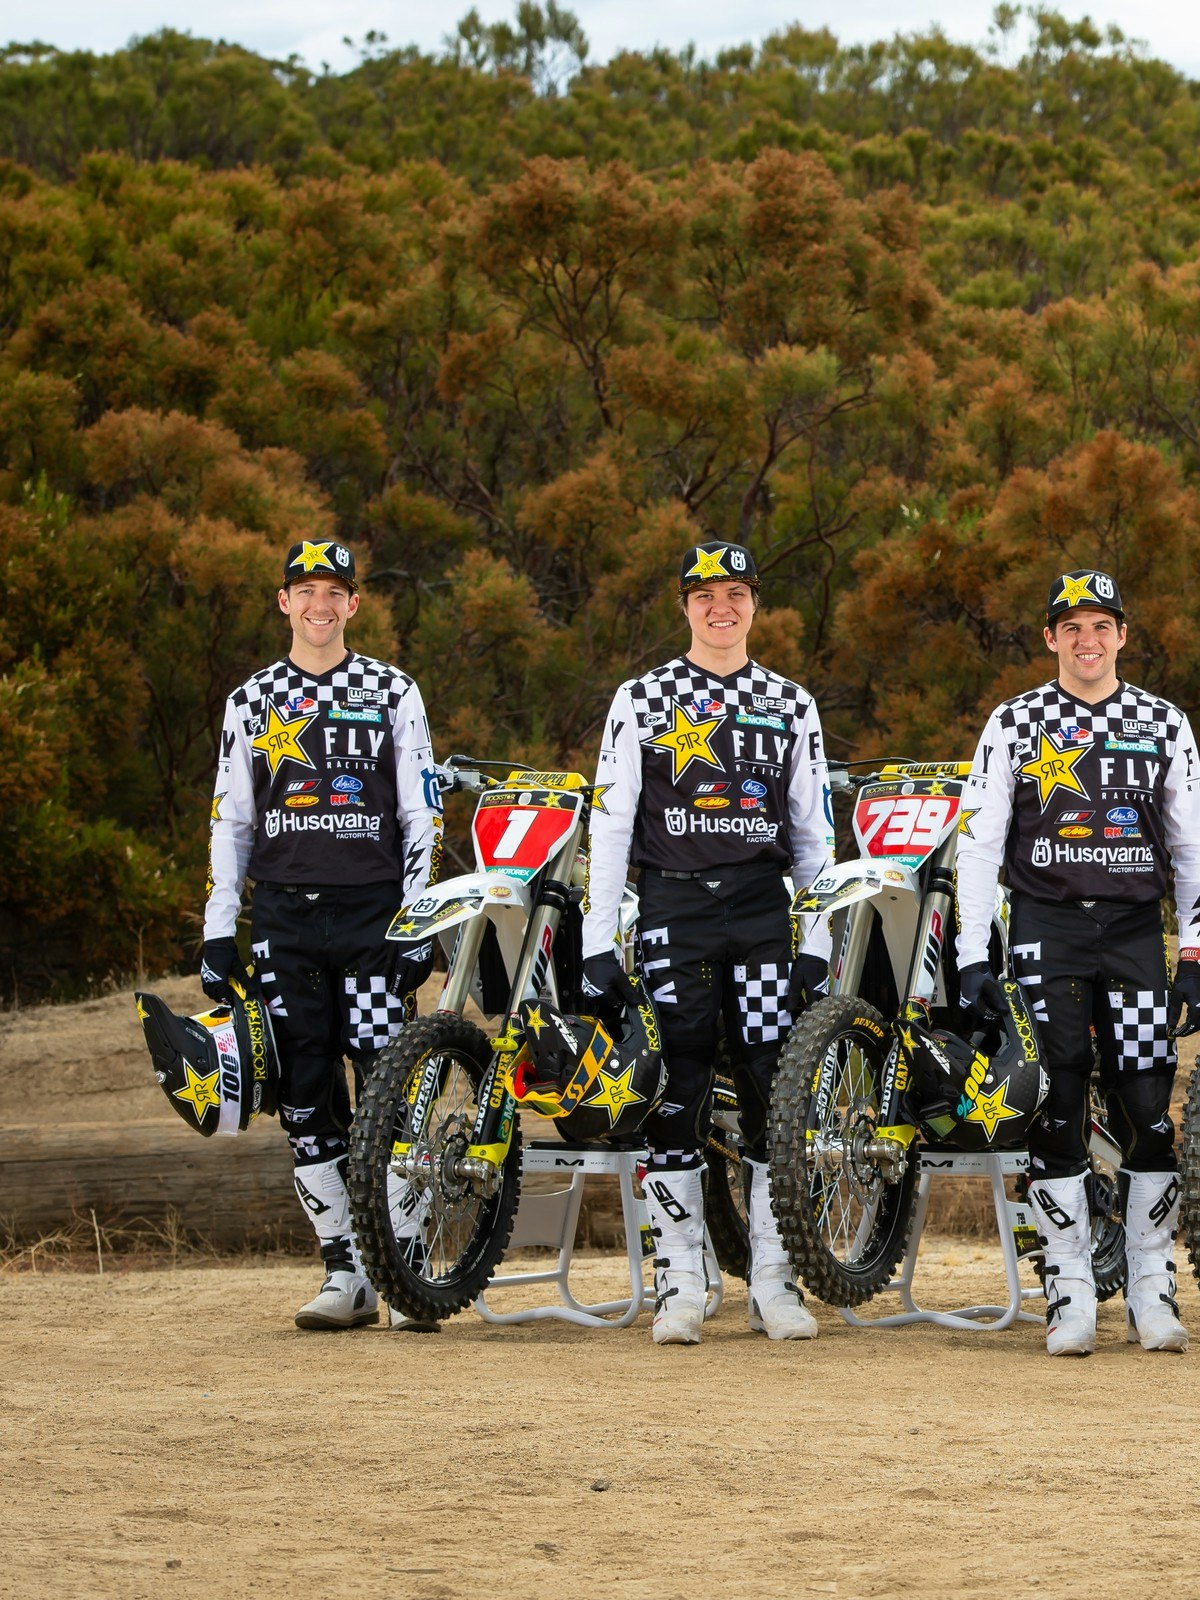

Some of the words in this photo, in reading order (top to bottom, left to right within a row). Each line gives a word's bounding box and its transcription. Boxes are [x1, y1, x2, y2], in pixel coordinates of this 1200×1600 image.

[350, 688, 383, 701] WPS
[285, 696, 306, 712] VP
[692, 698, 714, 713] VP
[753, 696, 786, 710] WPS
[341, 711, 380, 722] MOTOREX
[748, 717, 785, 729] MOTOREX
[1059, 726, 1081, 740] VP
[1124, 720, 1158, 733] WPS
[323, 727, 385, 758] FLY
[732, 730, 789, 763] FLY
[1118, 742, 1158, 754] MOTOREX
[326, 760, 376, 771] RACING
[735, 764, 782, 778] RCING
[518, 770, 567, 786] PROTAPER
[1099, 757, 1160, 789] FLY
[866, 785, 898, 795] ROCKSTAR
[484, 794, 517, 802] ROCKSTAR
[690, 814, 777, 837] Husqvaa
[862, 798, 951, 846] 739
[336, 832, 365, 840] FACTORY
[493, 810, 538, 859] 1
[885, 856, 921, 864] MOTOREX
[1055, 843, 1154, 867] Husqvarna
[497, 868, 530, 877] MOTOREX
[852, 1017, 885, 1039] DUNLOP
[245, 1001, 267, 1081] ROCKSTAR
[476, 1063, 496, 1134] DUNLO
